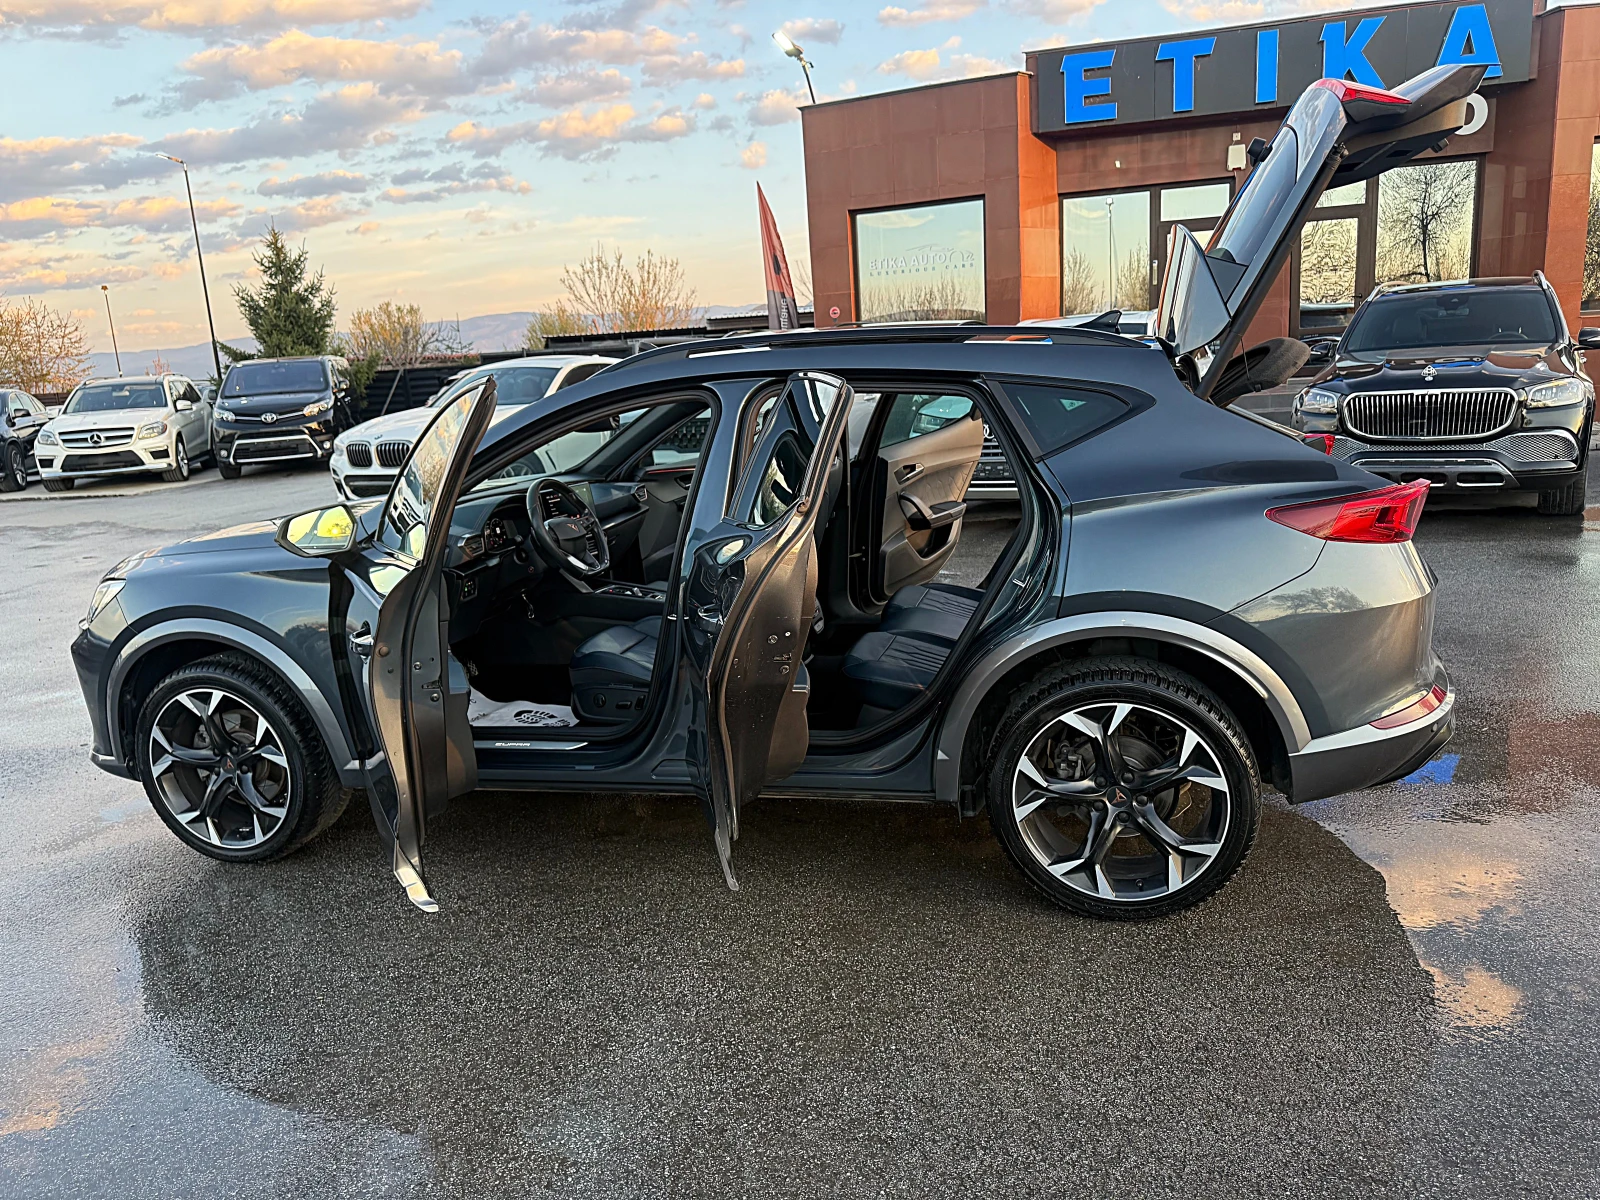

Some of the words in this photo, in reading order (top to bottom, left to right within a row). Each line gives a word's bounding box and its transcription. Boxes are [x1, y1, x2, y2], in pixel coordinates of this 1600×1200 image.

[1060, 3, 1504, 125] ETIKA
[870, 256, 907, 271] ETIKA
[910, 252, 947, 266] AUTO
[870, 266, 936, 277] LUXURIOUS
[945, 262, 974, 270] CARS
